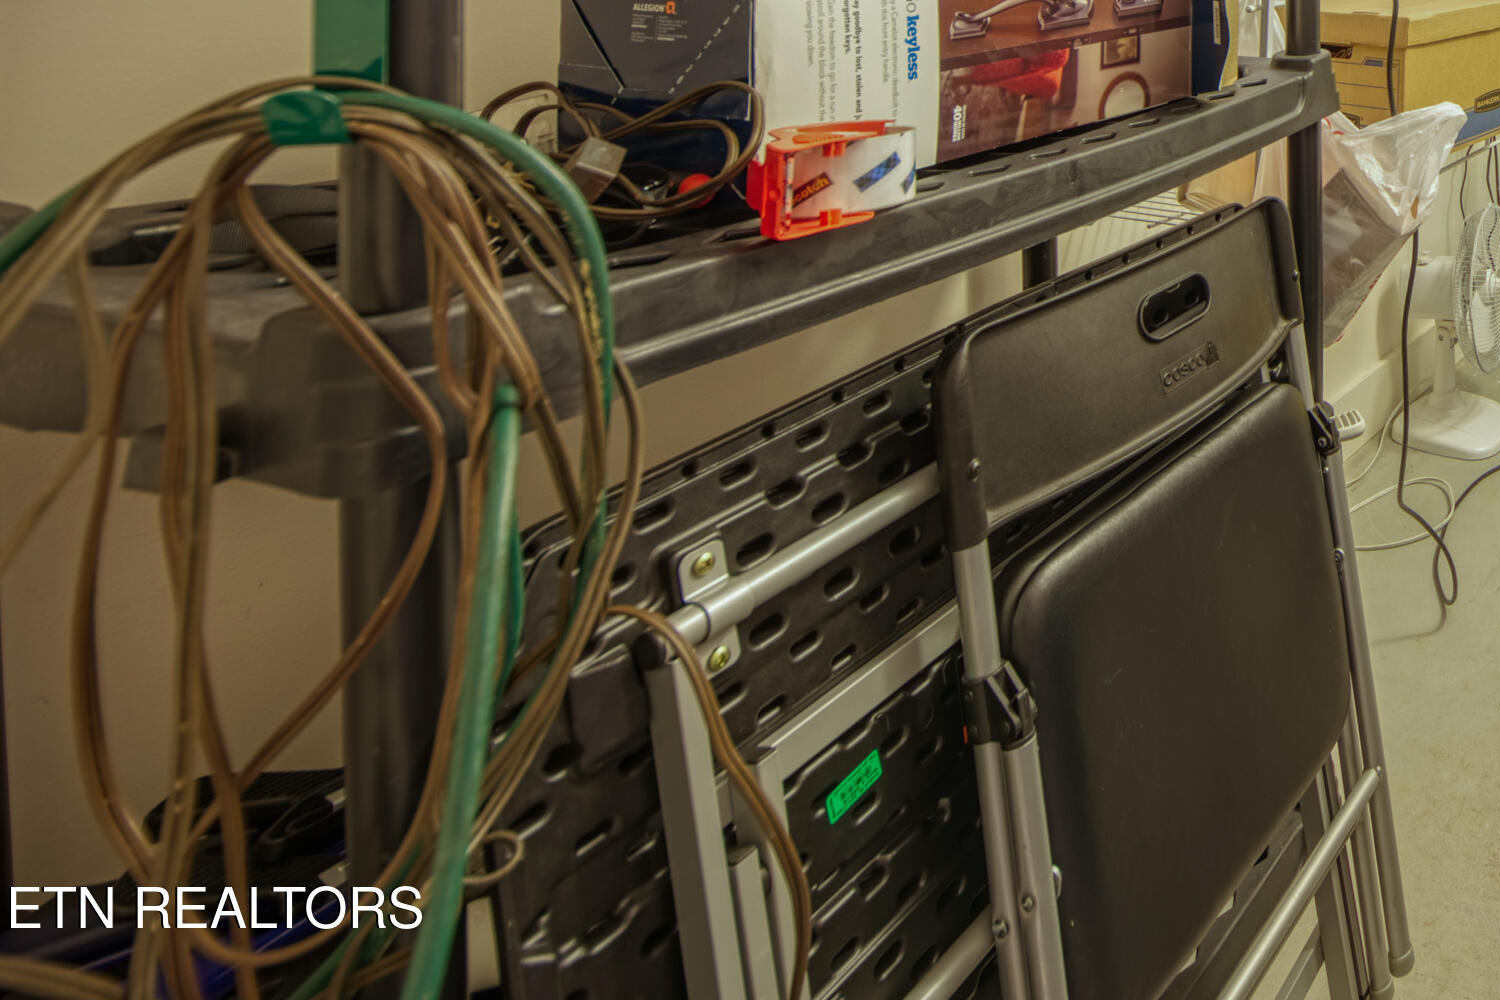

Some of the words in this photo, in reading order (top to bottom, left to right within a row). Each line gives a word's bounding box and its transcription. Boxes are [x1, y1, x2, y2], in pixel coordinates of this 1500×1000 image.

[632, 2, 665, 12] ALLEGION
[852, 10, 863, 44] goodbye
[843, 34, 853, 55] keys.
[855, 45, 863, 55] to
[854, 55, 864, 73] lost,
[855, 74, 864, 98] stolen
[855, 99, 864, 113] and
[1476, 95, 1500, 109] BANKERS
[952, 104, 962, 121] 40
[792, 176, 831, 204] cotch
